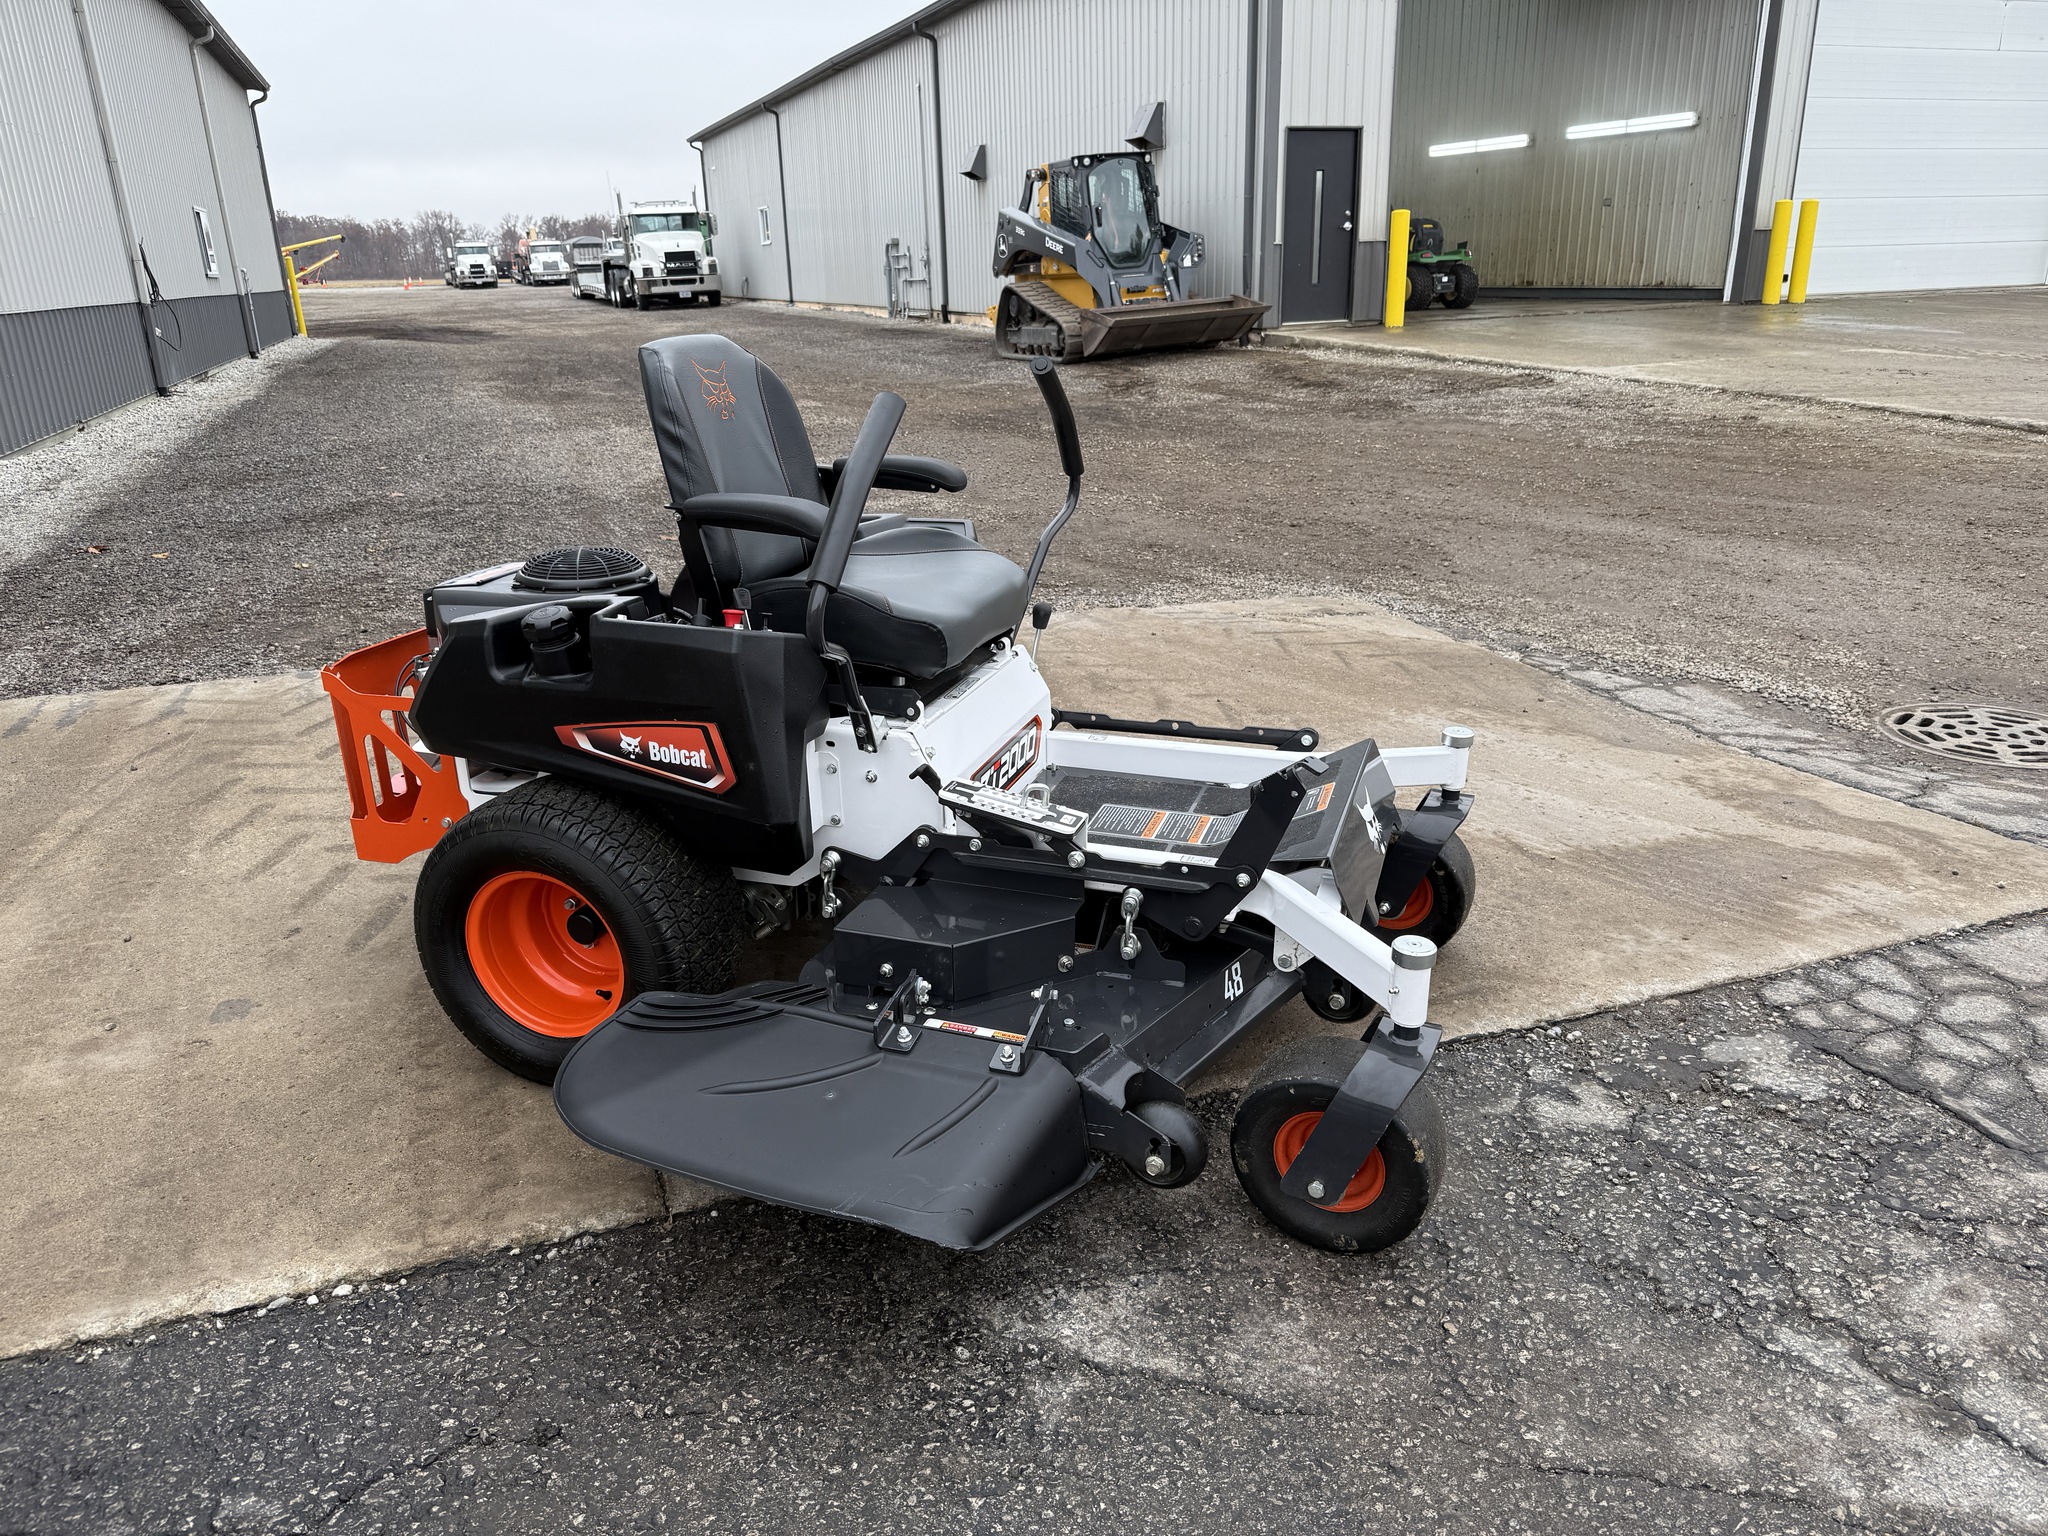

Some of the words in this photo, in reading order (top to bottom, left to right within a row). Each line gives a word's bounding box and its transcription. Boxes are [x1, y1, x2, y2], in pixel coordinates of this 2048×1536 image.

[1045, 236, 1064, 255] DEERE
[648, 741, 708, 769] Bobcat
[1224, 961, 1244, 1001] 48
[949, 1023, 977, 1032] DANGER
[1001, 1033, 1026, 1041] WARNIN
